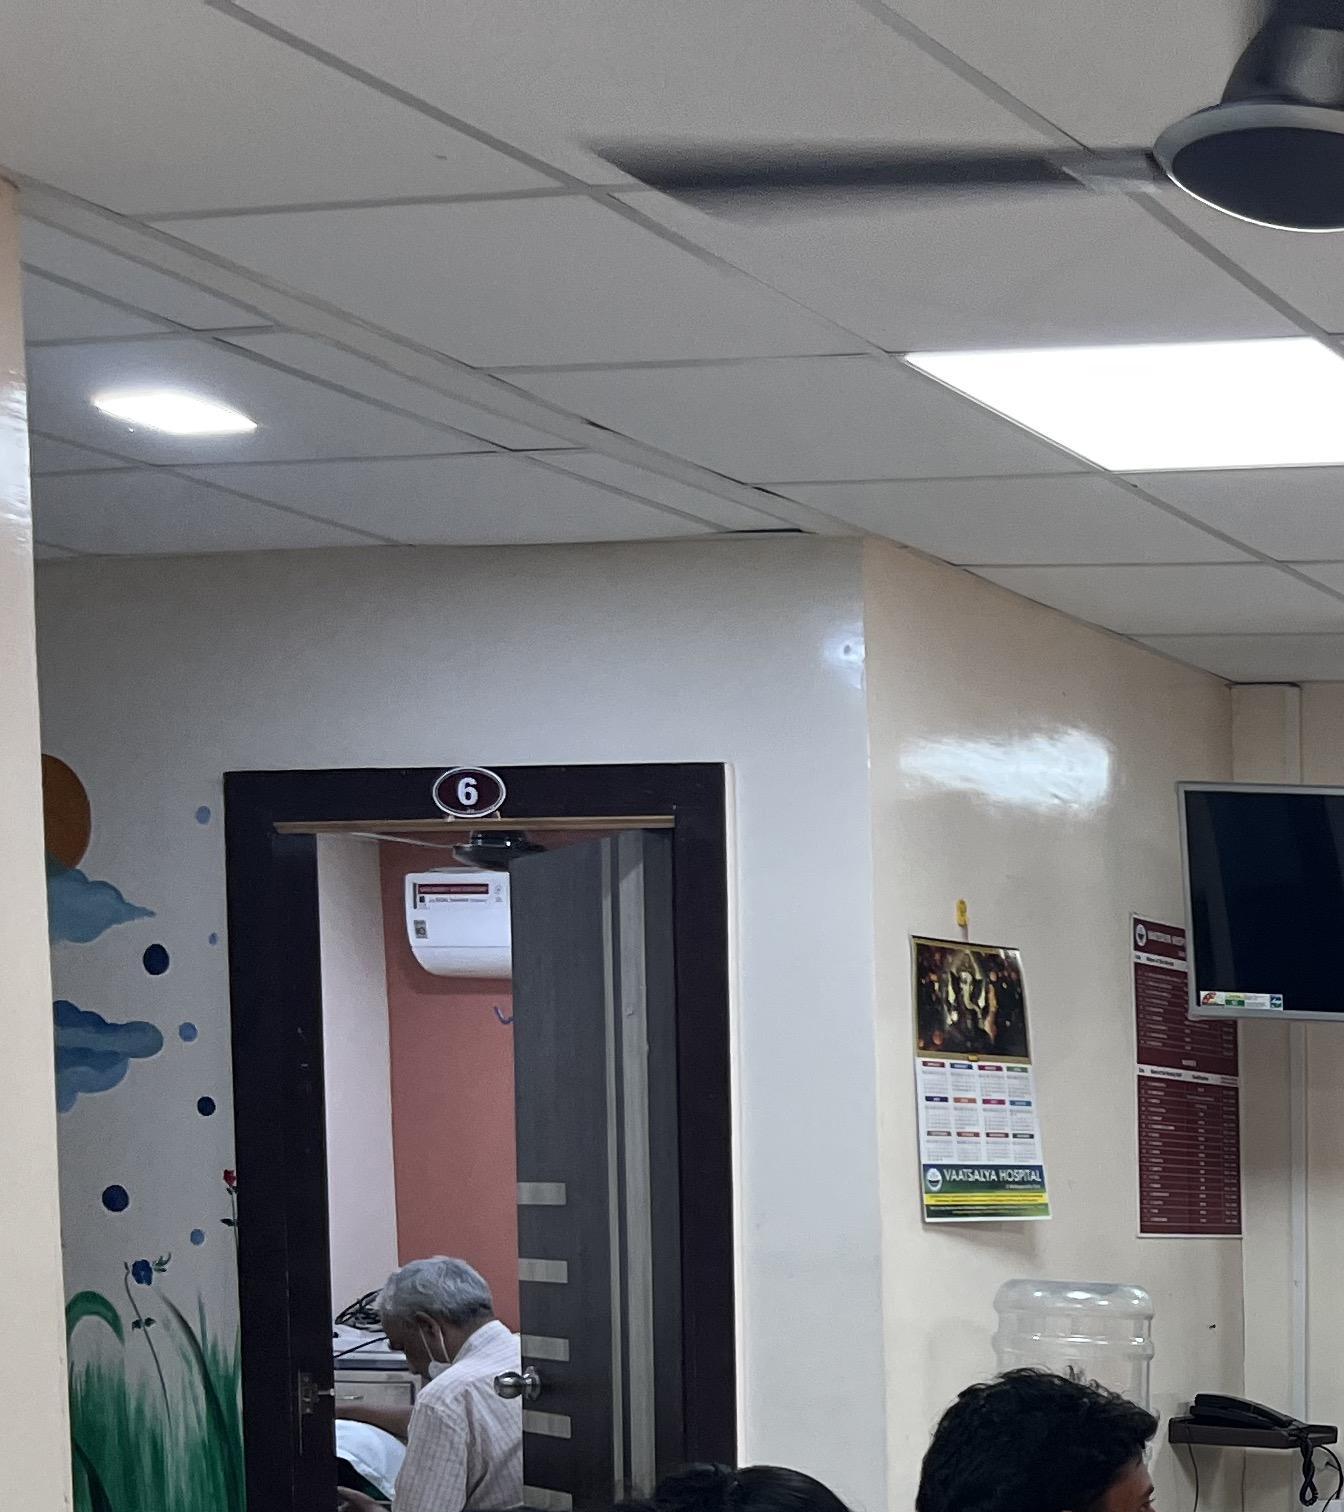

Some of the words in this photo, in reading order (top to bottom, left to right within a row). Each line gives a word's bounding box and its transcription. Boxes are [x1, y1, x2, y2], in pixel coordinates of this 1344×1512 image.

[458, 777, 479, 805] 6
[943, 1169, 997, 1182] VAATSALYA
[1000, 1169, 1042, 1182] HOSPITAL
